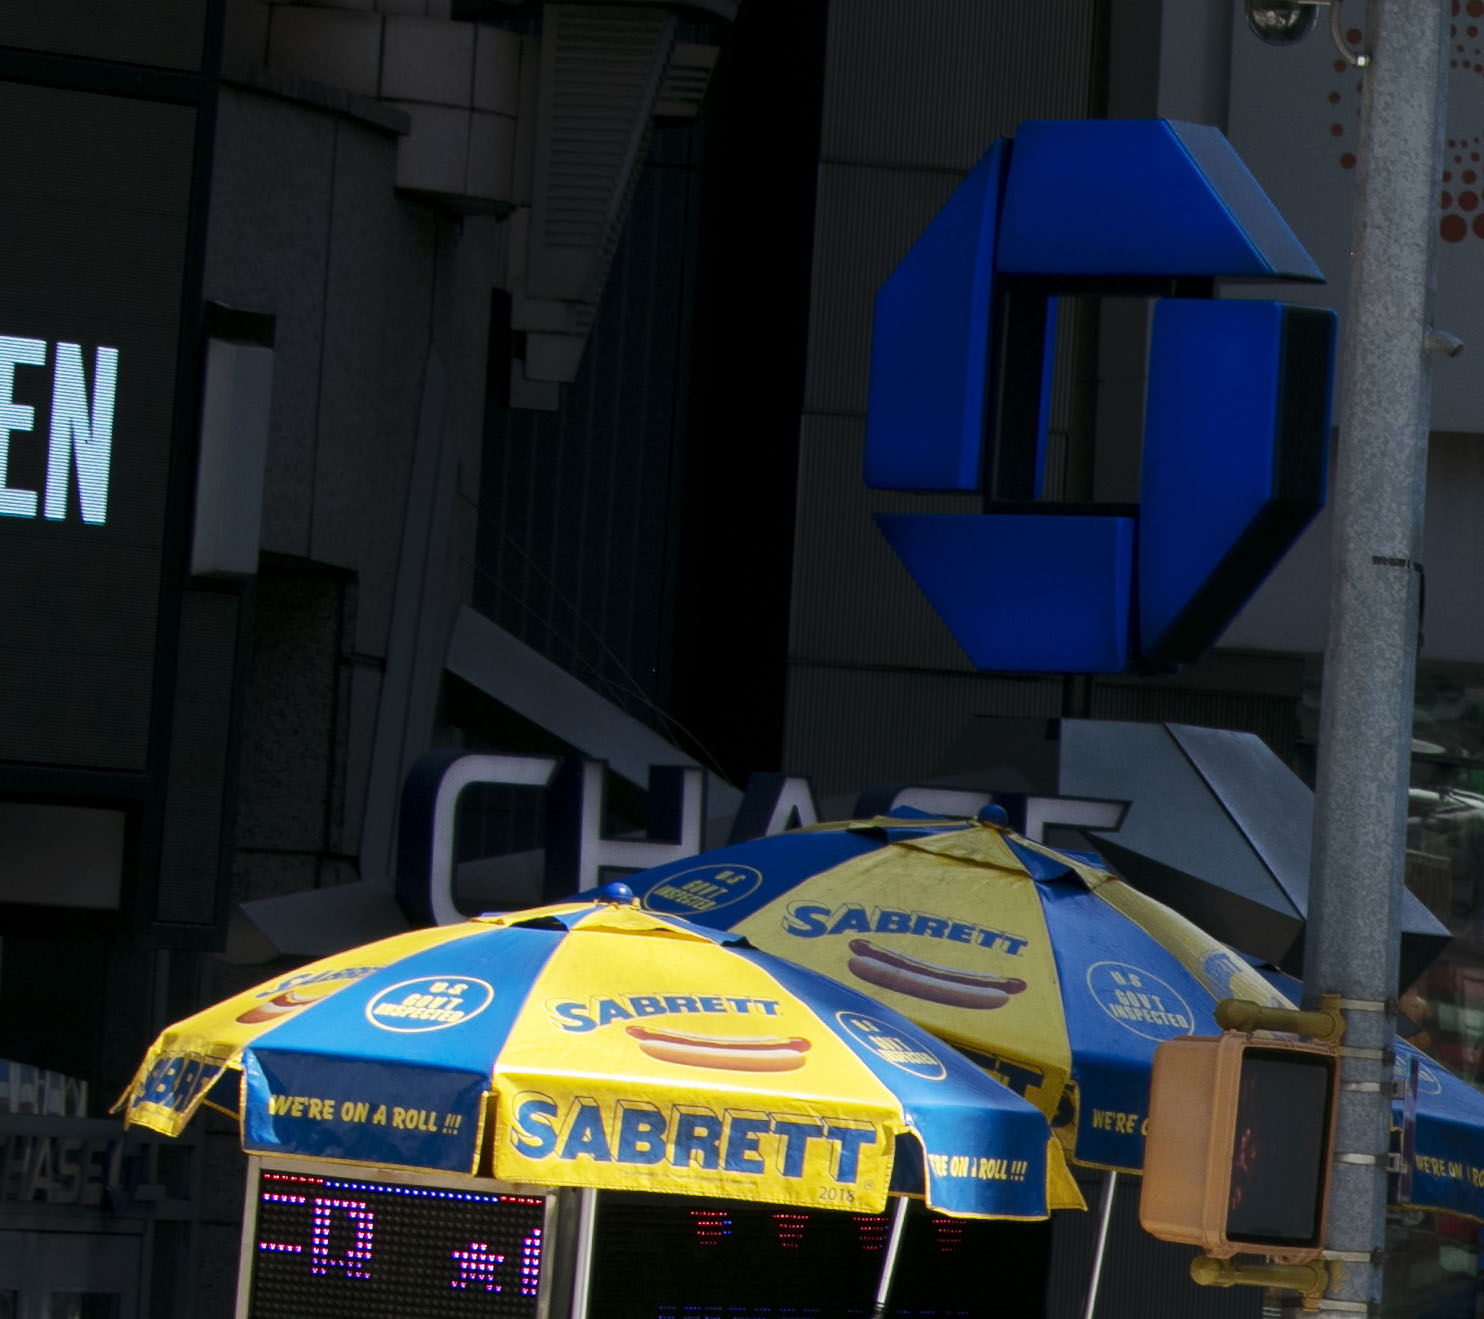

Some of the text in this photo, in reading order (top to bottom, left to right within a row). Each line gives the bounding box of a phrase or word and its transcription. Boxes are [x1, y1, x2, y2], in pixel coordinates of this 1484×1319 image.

[781, 898, 1029, 956] SABRETT
[545, 993, 784, 1032] SABRETT
[269, 1094, 334, 1122] WE'RE
[343, 1100, 368, 1122] ON
[373, 1104, 387, 1124] A
[393, 1106, 438, 1133] ROLL
[1091, 1108, 1136, 1137] WE'RE
[509, 1090, 878, 1184] SABRETT
[818, 1184, 856, 1202] 2018
